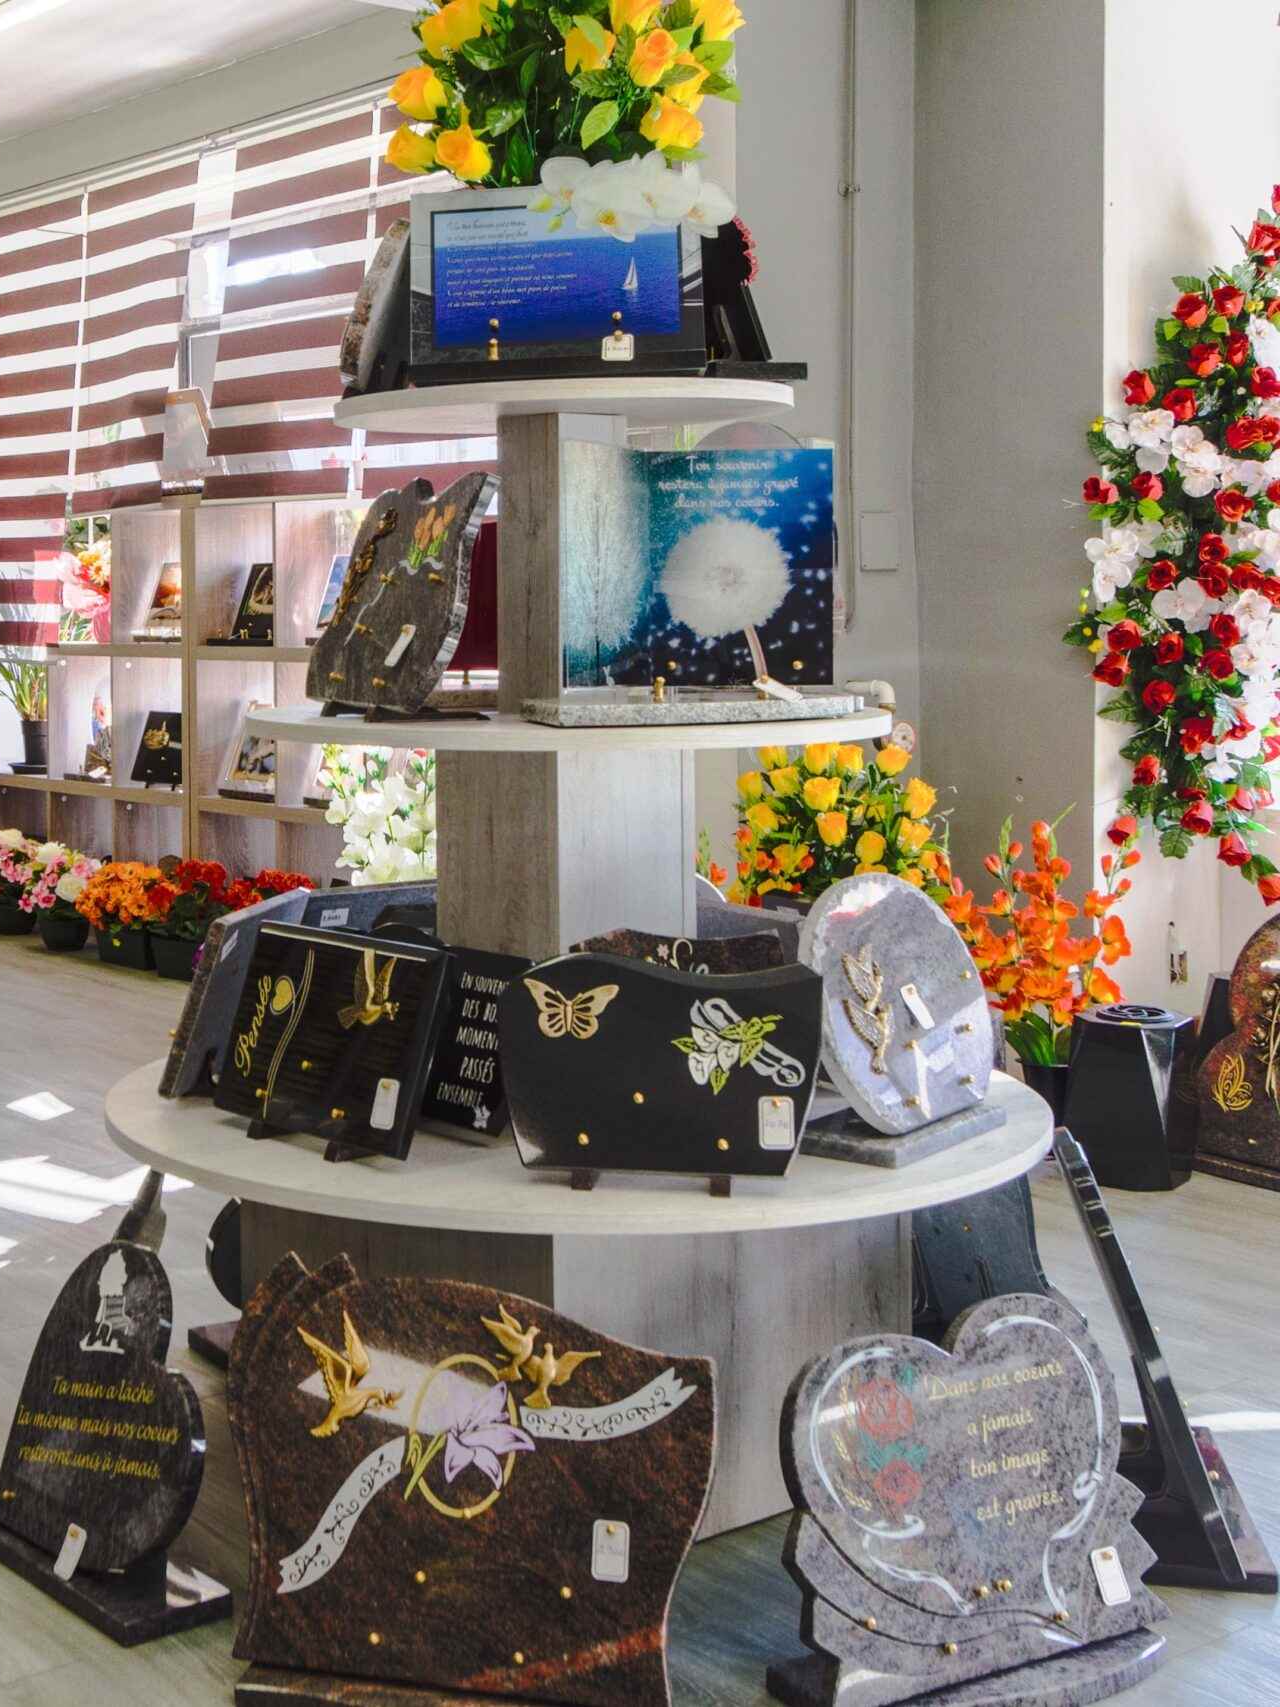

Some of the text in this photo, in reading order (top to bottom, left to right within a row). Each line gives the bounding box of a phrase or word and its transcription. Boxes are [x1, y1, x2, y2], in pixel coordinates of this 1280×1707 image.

[685, 455, 711, 474] Ton
[461, 971, 473, 990] EN
[462, 998, 480, 1019] DES
[460, 1056, 496, 1084] PASSÉS
[1001, 1448, 1049, 1477] image
